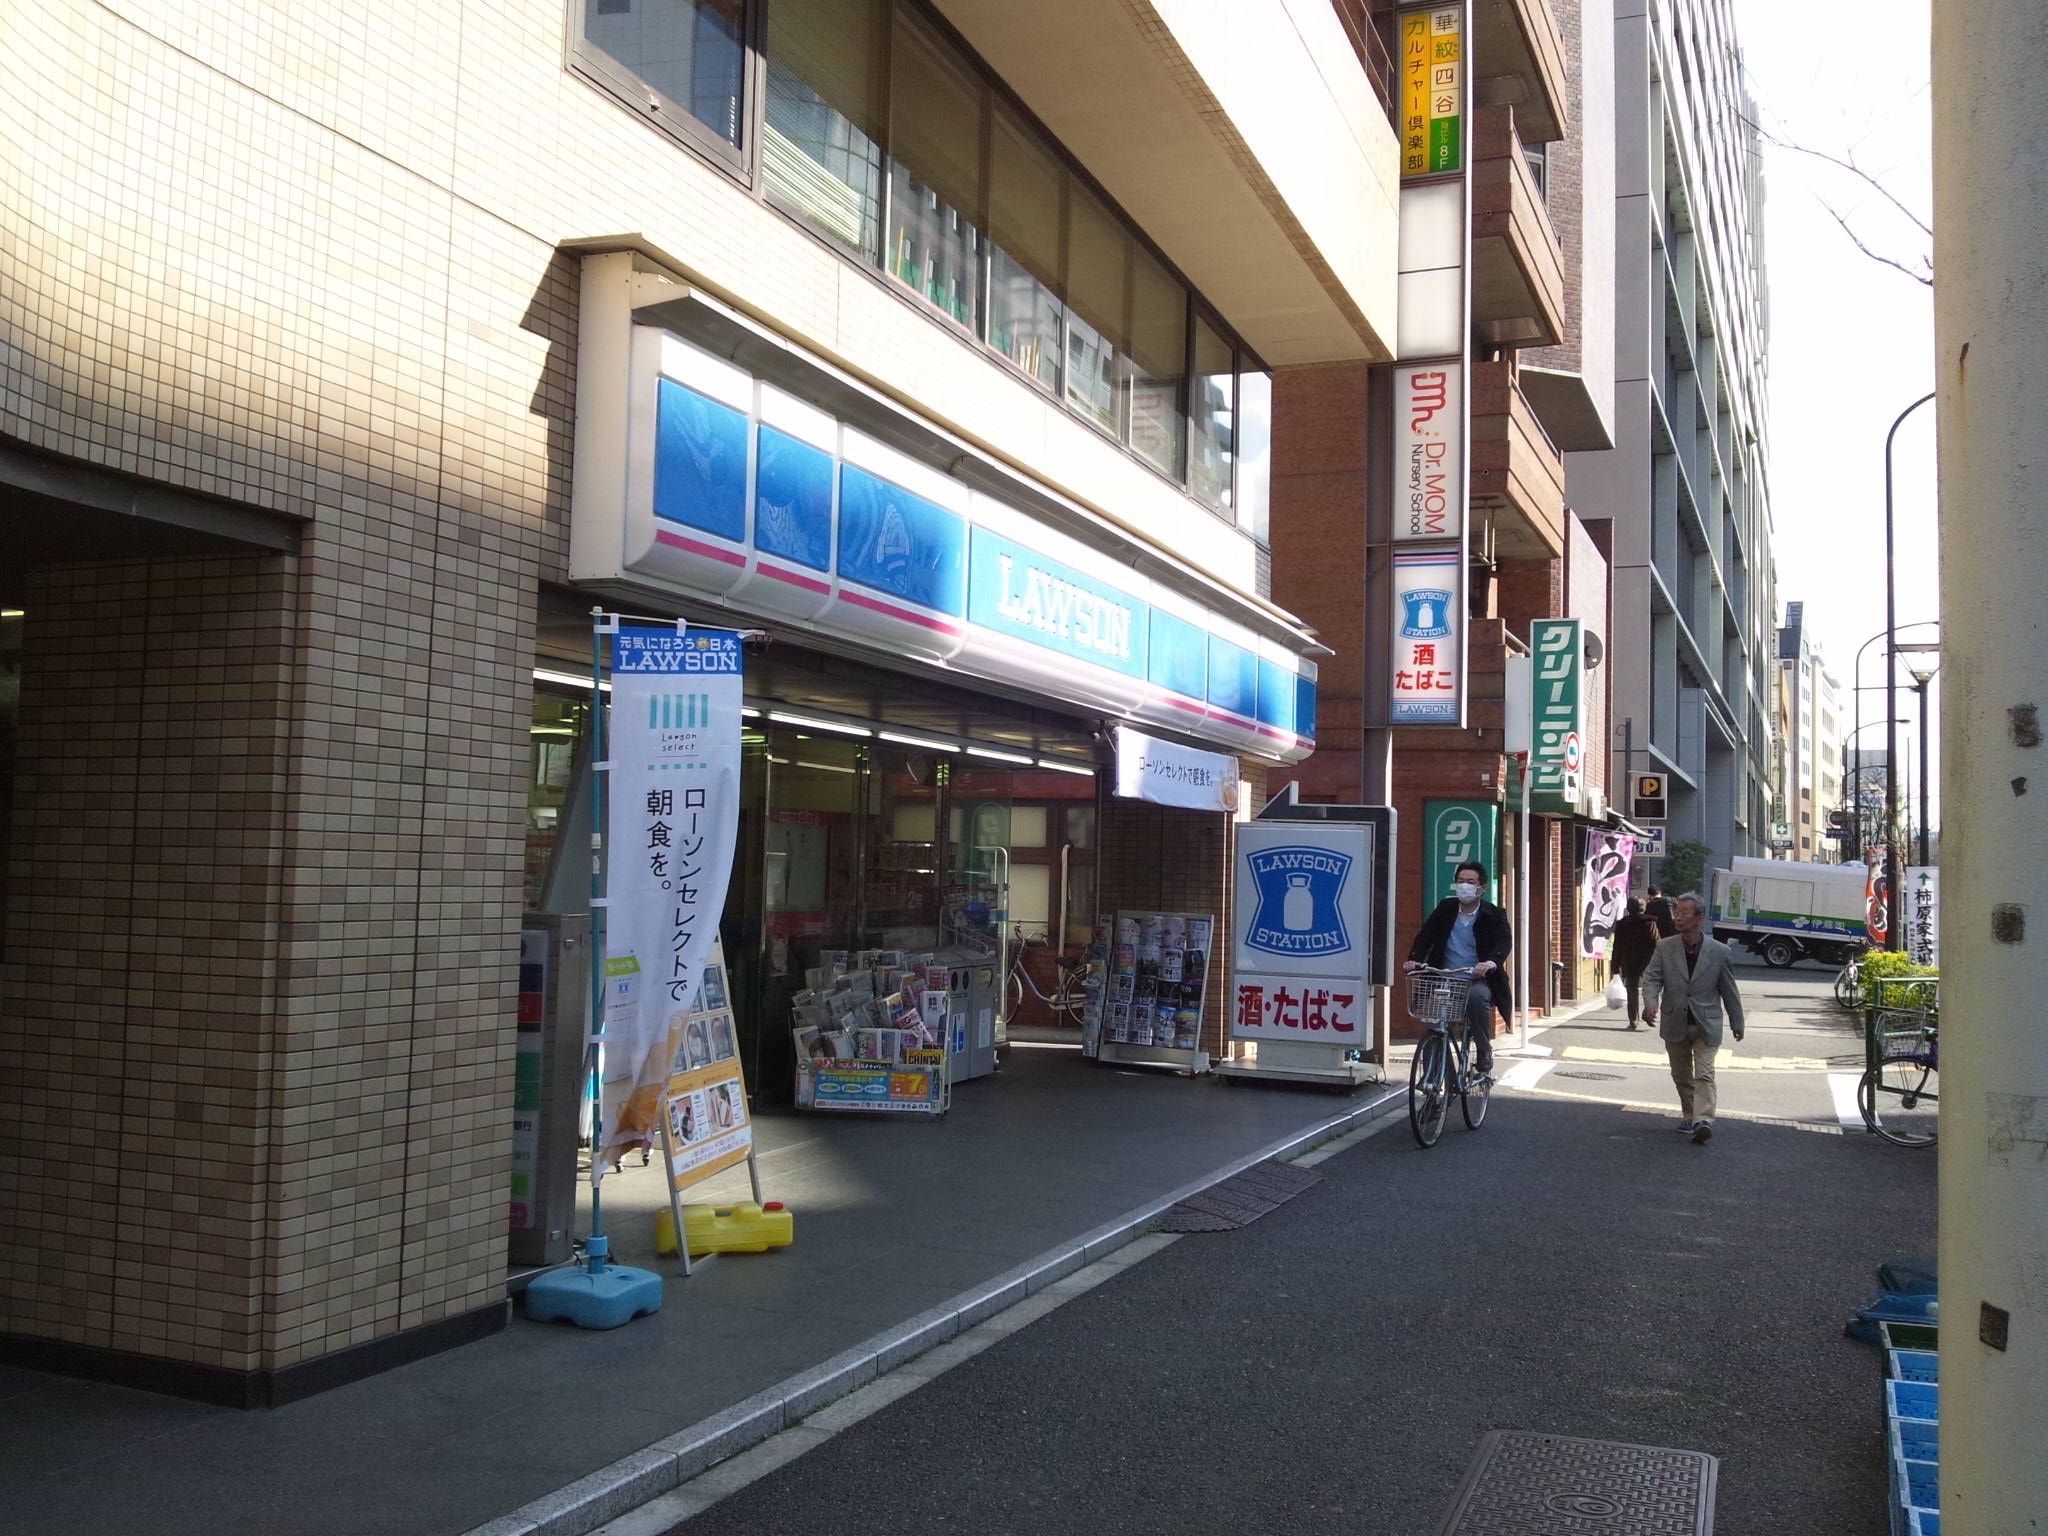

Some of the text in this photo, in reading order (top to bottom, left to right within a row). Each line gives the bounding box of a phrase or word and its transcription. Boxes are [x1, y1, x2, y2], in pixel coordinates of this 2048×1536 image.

[1434, 13, 1455, 114] 華紋四谷
[1407, 18, 1425, 170] カルチャー倶楽部
[1409, 444, 1424, 535] Nursery School
[1425, 442, 1446, 534] Dr. MOM
[996, 553, 1131, 660] LAWSON
[1405, 591, 1447, 603] LAWSON
[1405, 626, 1446, 637] STATION
[620, 637, 737, 651] 元気になろう 日本
[619, 651, 738, 671] LAWSON
[1413, 644, 1435, 666] 酒
[1396, 670, 1454, 690] たばこ
[1399, 704, 1449, 714] LAWSON
[662, 743, 695, 751] select
[1643, 778, 1659, 796] P
[646, 789, 673, 892] 朝食を。
[1257, 854, 1343, 876] LAWSON
[666, 789, 706, 1002] ローソンセレクトで
[1256, 929, 1341, 948] STATION
